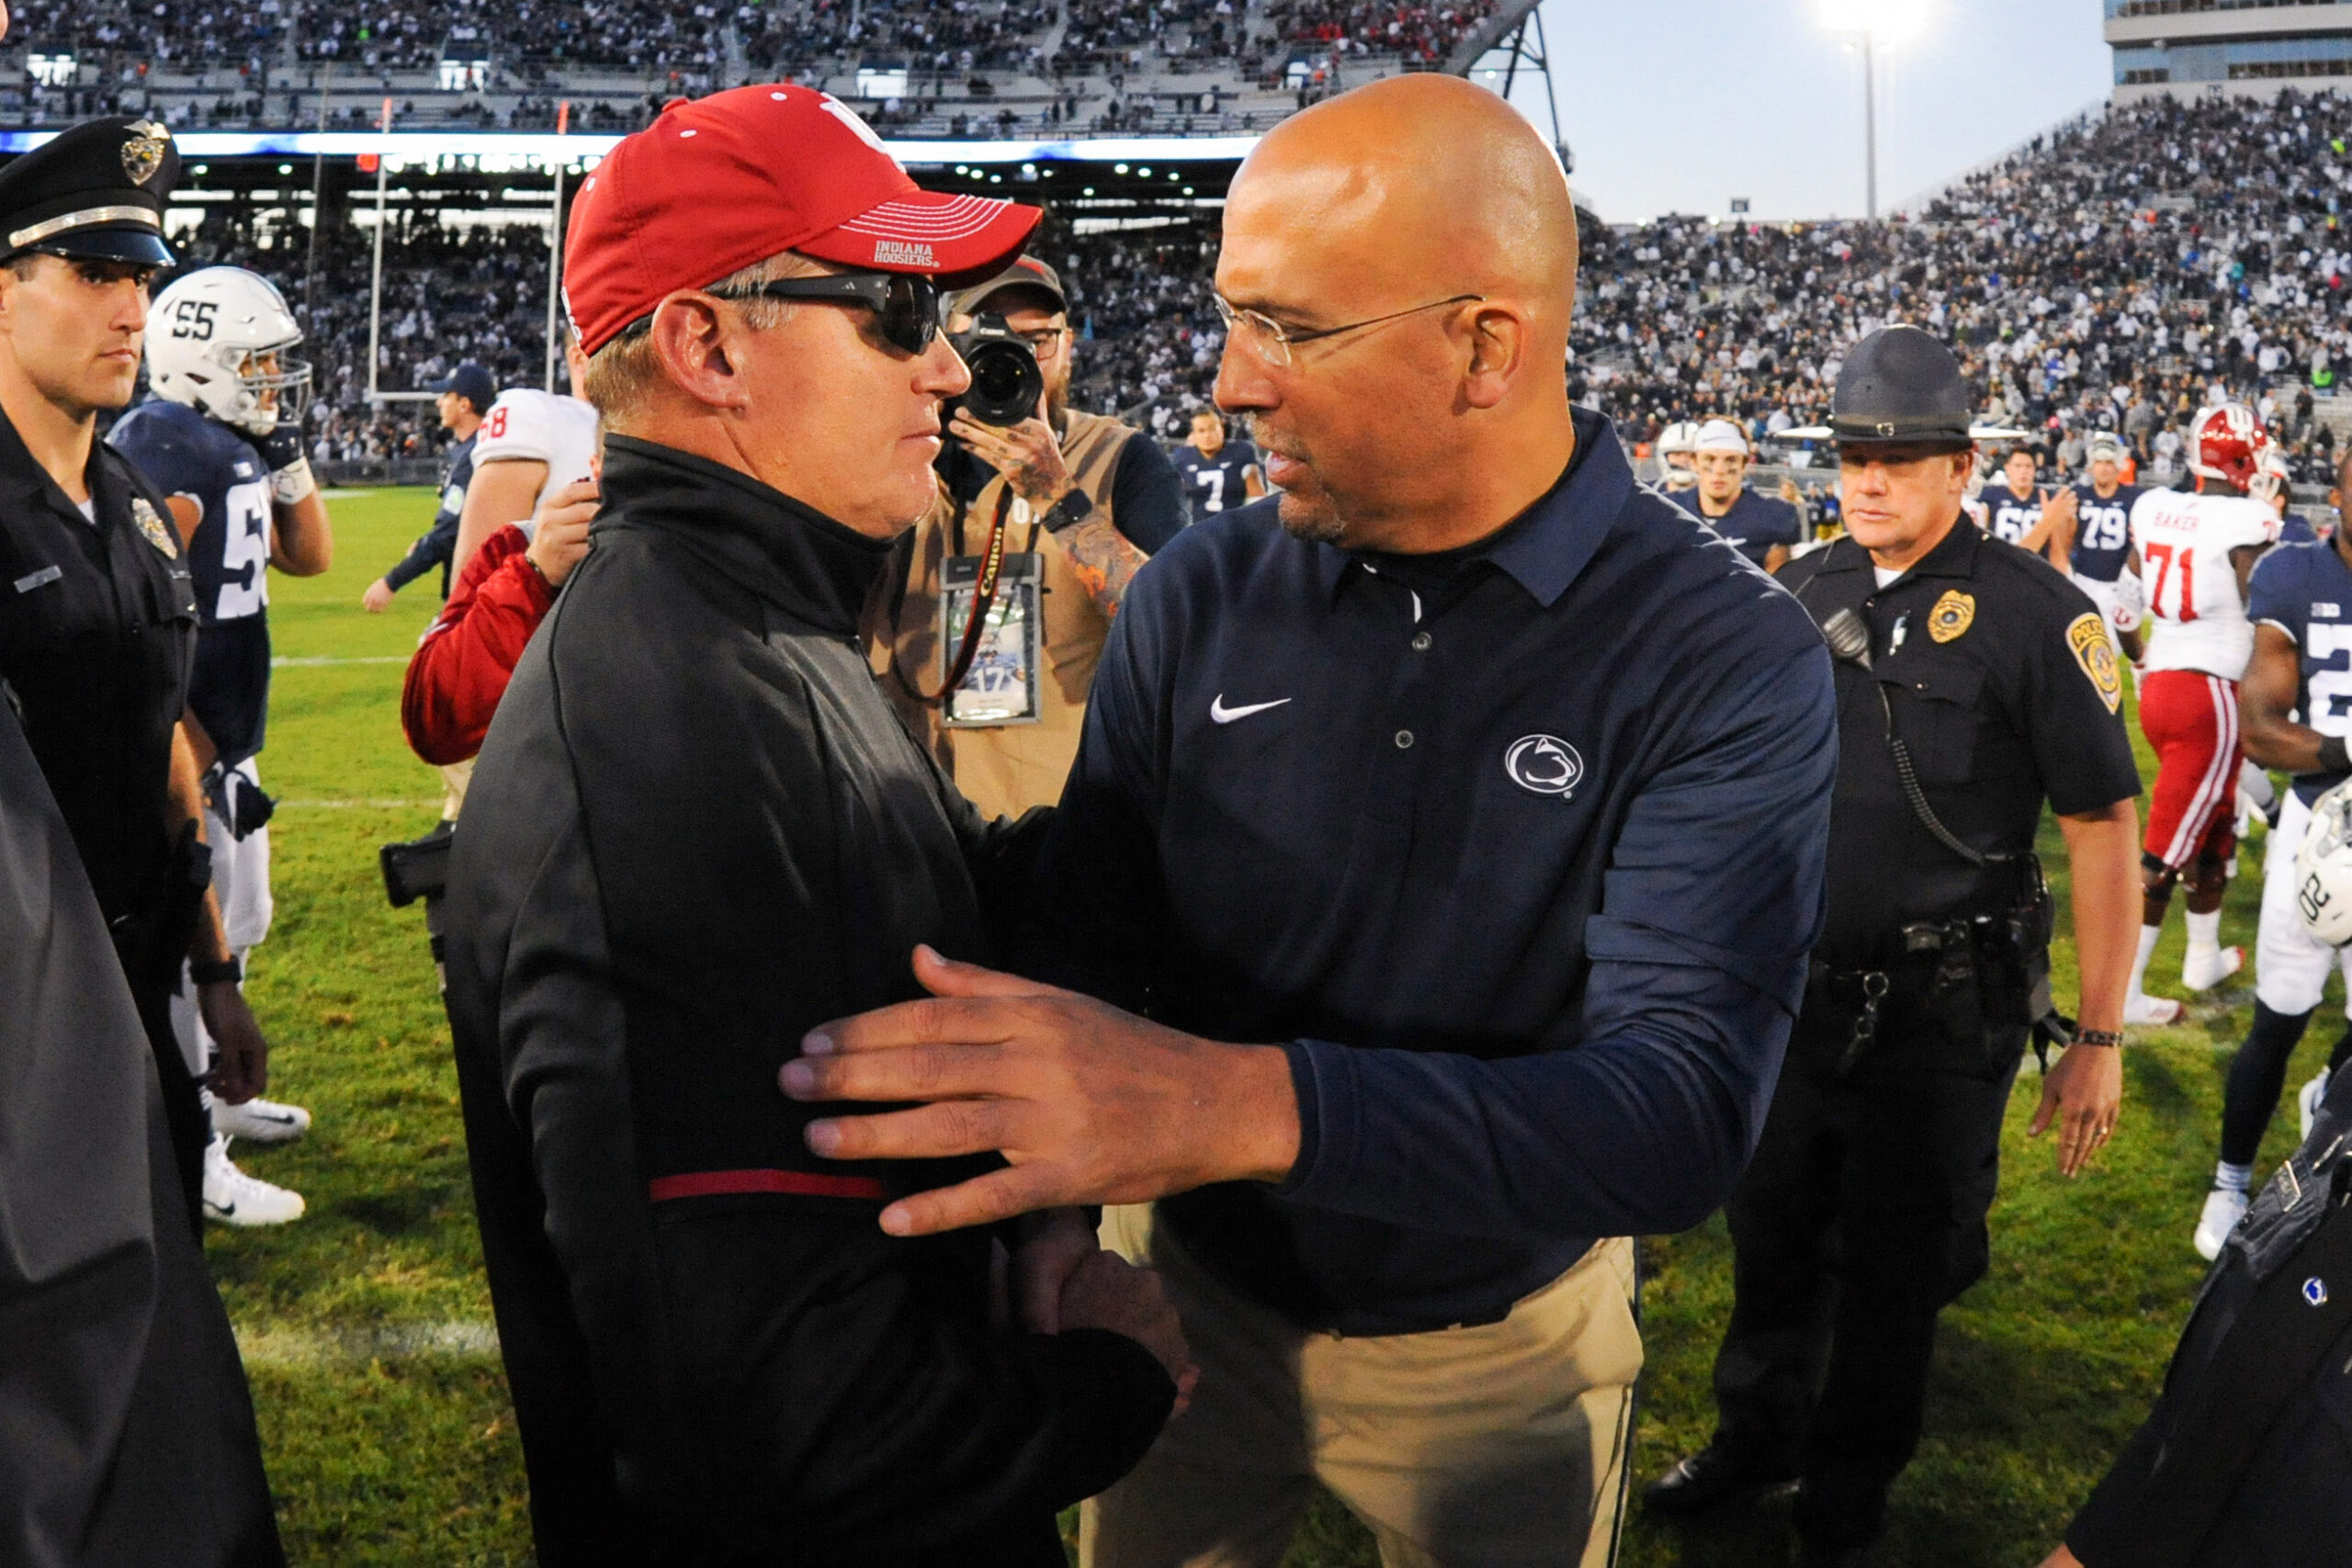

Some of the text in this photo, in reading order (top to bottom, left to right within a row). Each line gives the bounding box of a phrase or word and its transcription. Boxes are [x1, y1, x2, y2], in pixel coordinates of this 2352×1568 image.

[874, 252, 933, 266] HOOSIERS
[876, 240, 933, 255] INDIANA
[172, 300, 219, 341] 55
[1196, 469, 1224, 512] 7
[215, 476, 273, 620] 5
[2079, 506, 2127, 550] 79
[980, 526, 1002, 597] Canon
[2145, 541, 2199, 623] 71
[2299, 873, 2331, 921] 20
